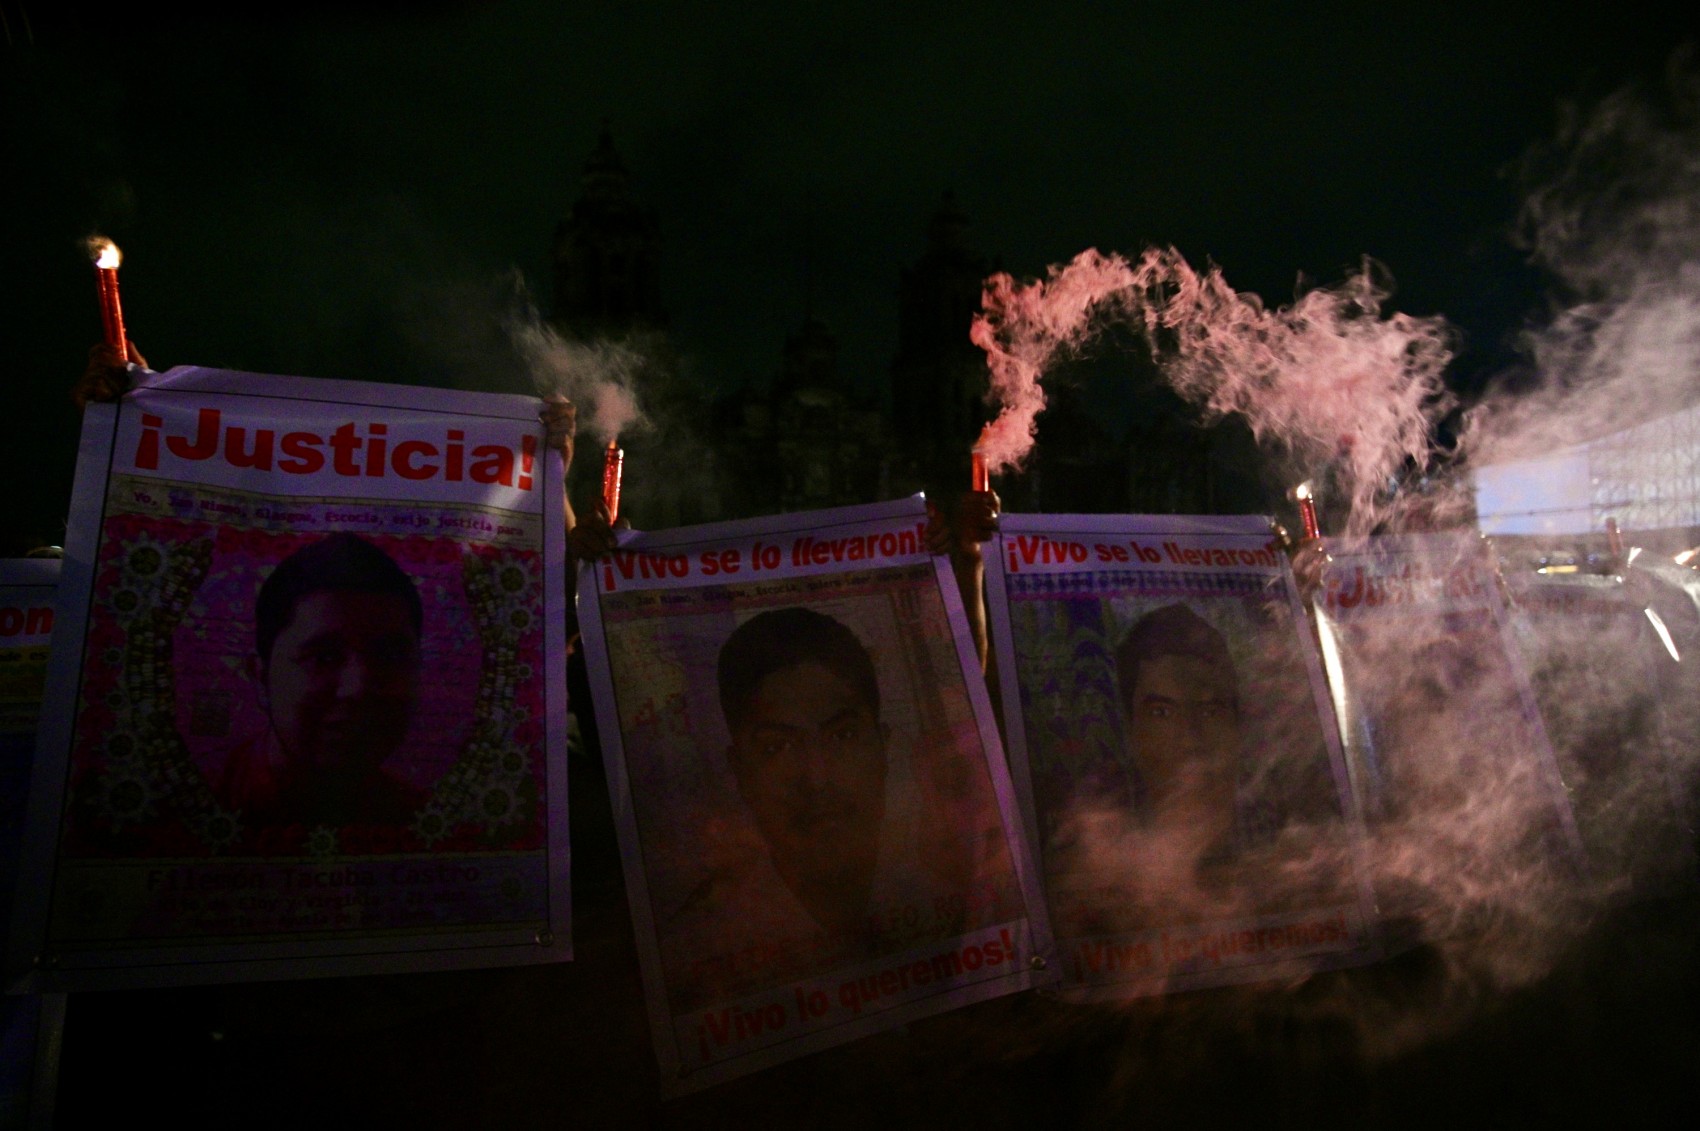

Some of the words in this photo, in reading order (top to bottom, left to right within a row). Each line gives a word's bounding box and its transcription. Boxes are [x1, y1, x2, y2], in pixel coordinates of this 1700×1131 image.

[135, 408, 537, 491] ¡Justicia!
[134, 491, 158, 506] Yo,
[168, 495, 194, 508] Jan
[256, 508, 316, 524] Glasgow,
[438, 516, 493, 532] justicia
[497, 525, 524, 539] para
[602, 549, 688, 591] ¡Vivo
[701, 549, 740, 575] se
[752, 541, 781, 570] lo
[792, 523, 925, 566] llevaron!
[1008, 535, 1088, 572] ¡Vivo
[1094, 542, 1128, 562] se
[1131, 542, 1161, 563] lo
[1163, 542, 1278, 567] llevaron!
[700, 1002, 787, 1061] ¡Vivo
[796, 986, 830, 1022] lo
[838, 929, 1015, 1014] queremos!
